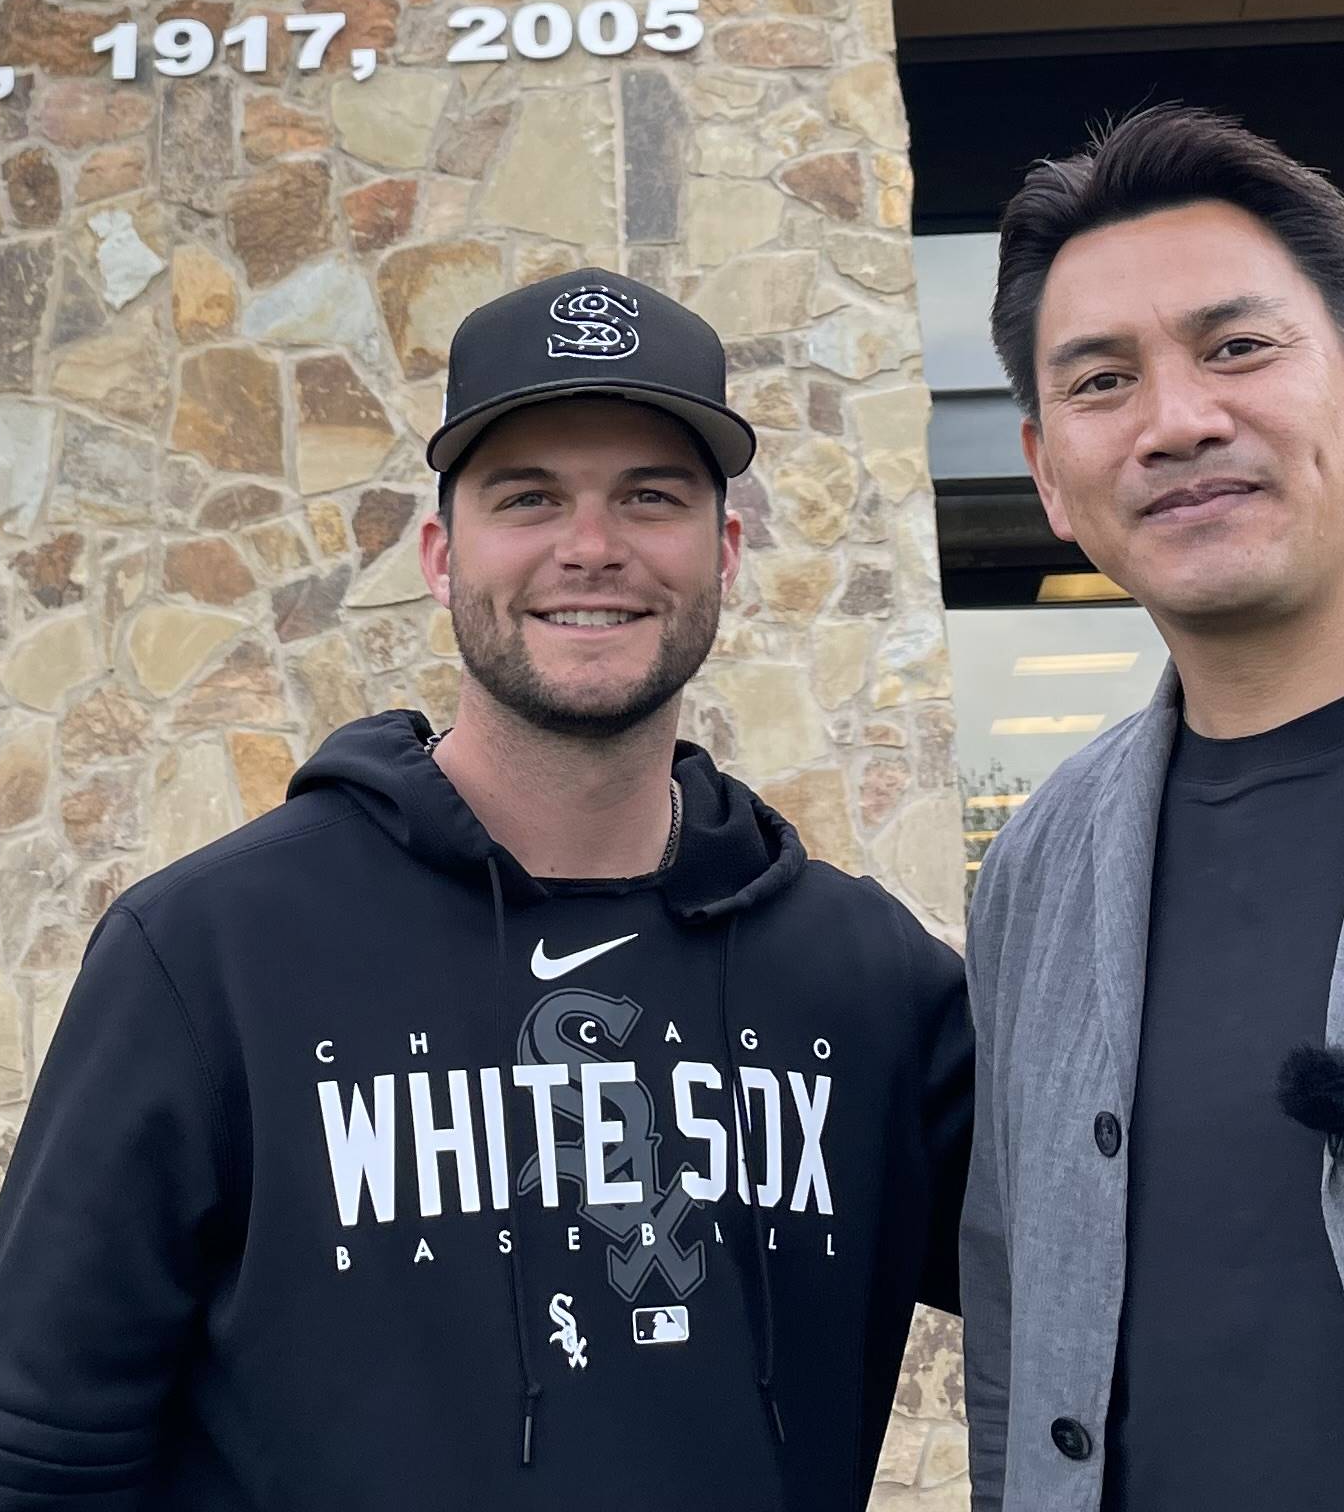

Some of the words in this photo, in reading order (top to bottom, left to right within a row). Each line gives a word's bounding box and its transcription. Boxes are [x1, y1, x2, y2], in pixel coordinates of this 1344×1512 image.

[92, 12, 378, 82] 1917,
[315, 1020, 832, 1064] CHCAGO
[317, 1061, 645, 1228] WHITE
[671, 1060, 834, 1216] SOX
